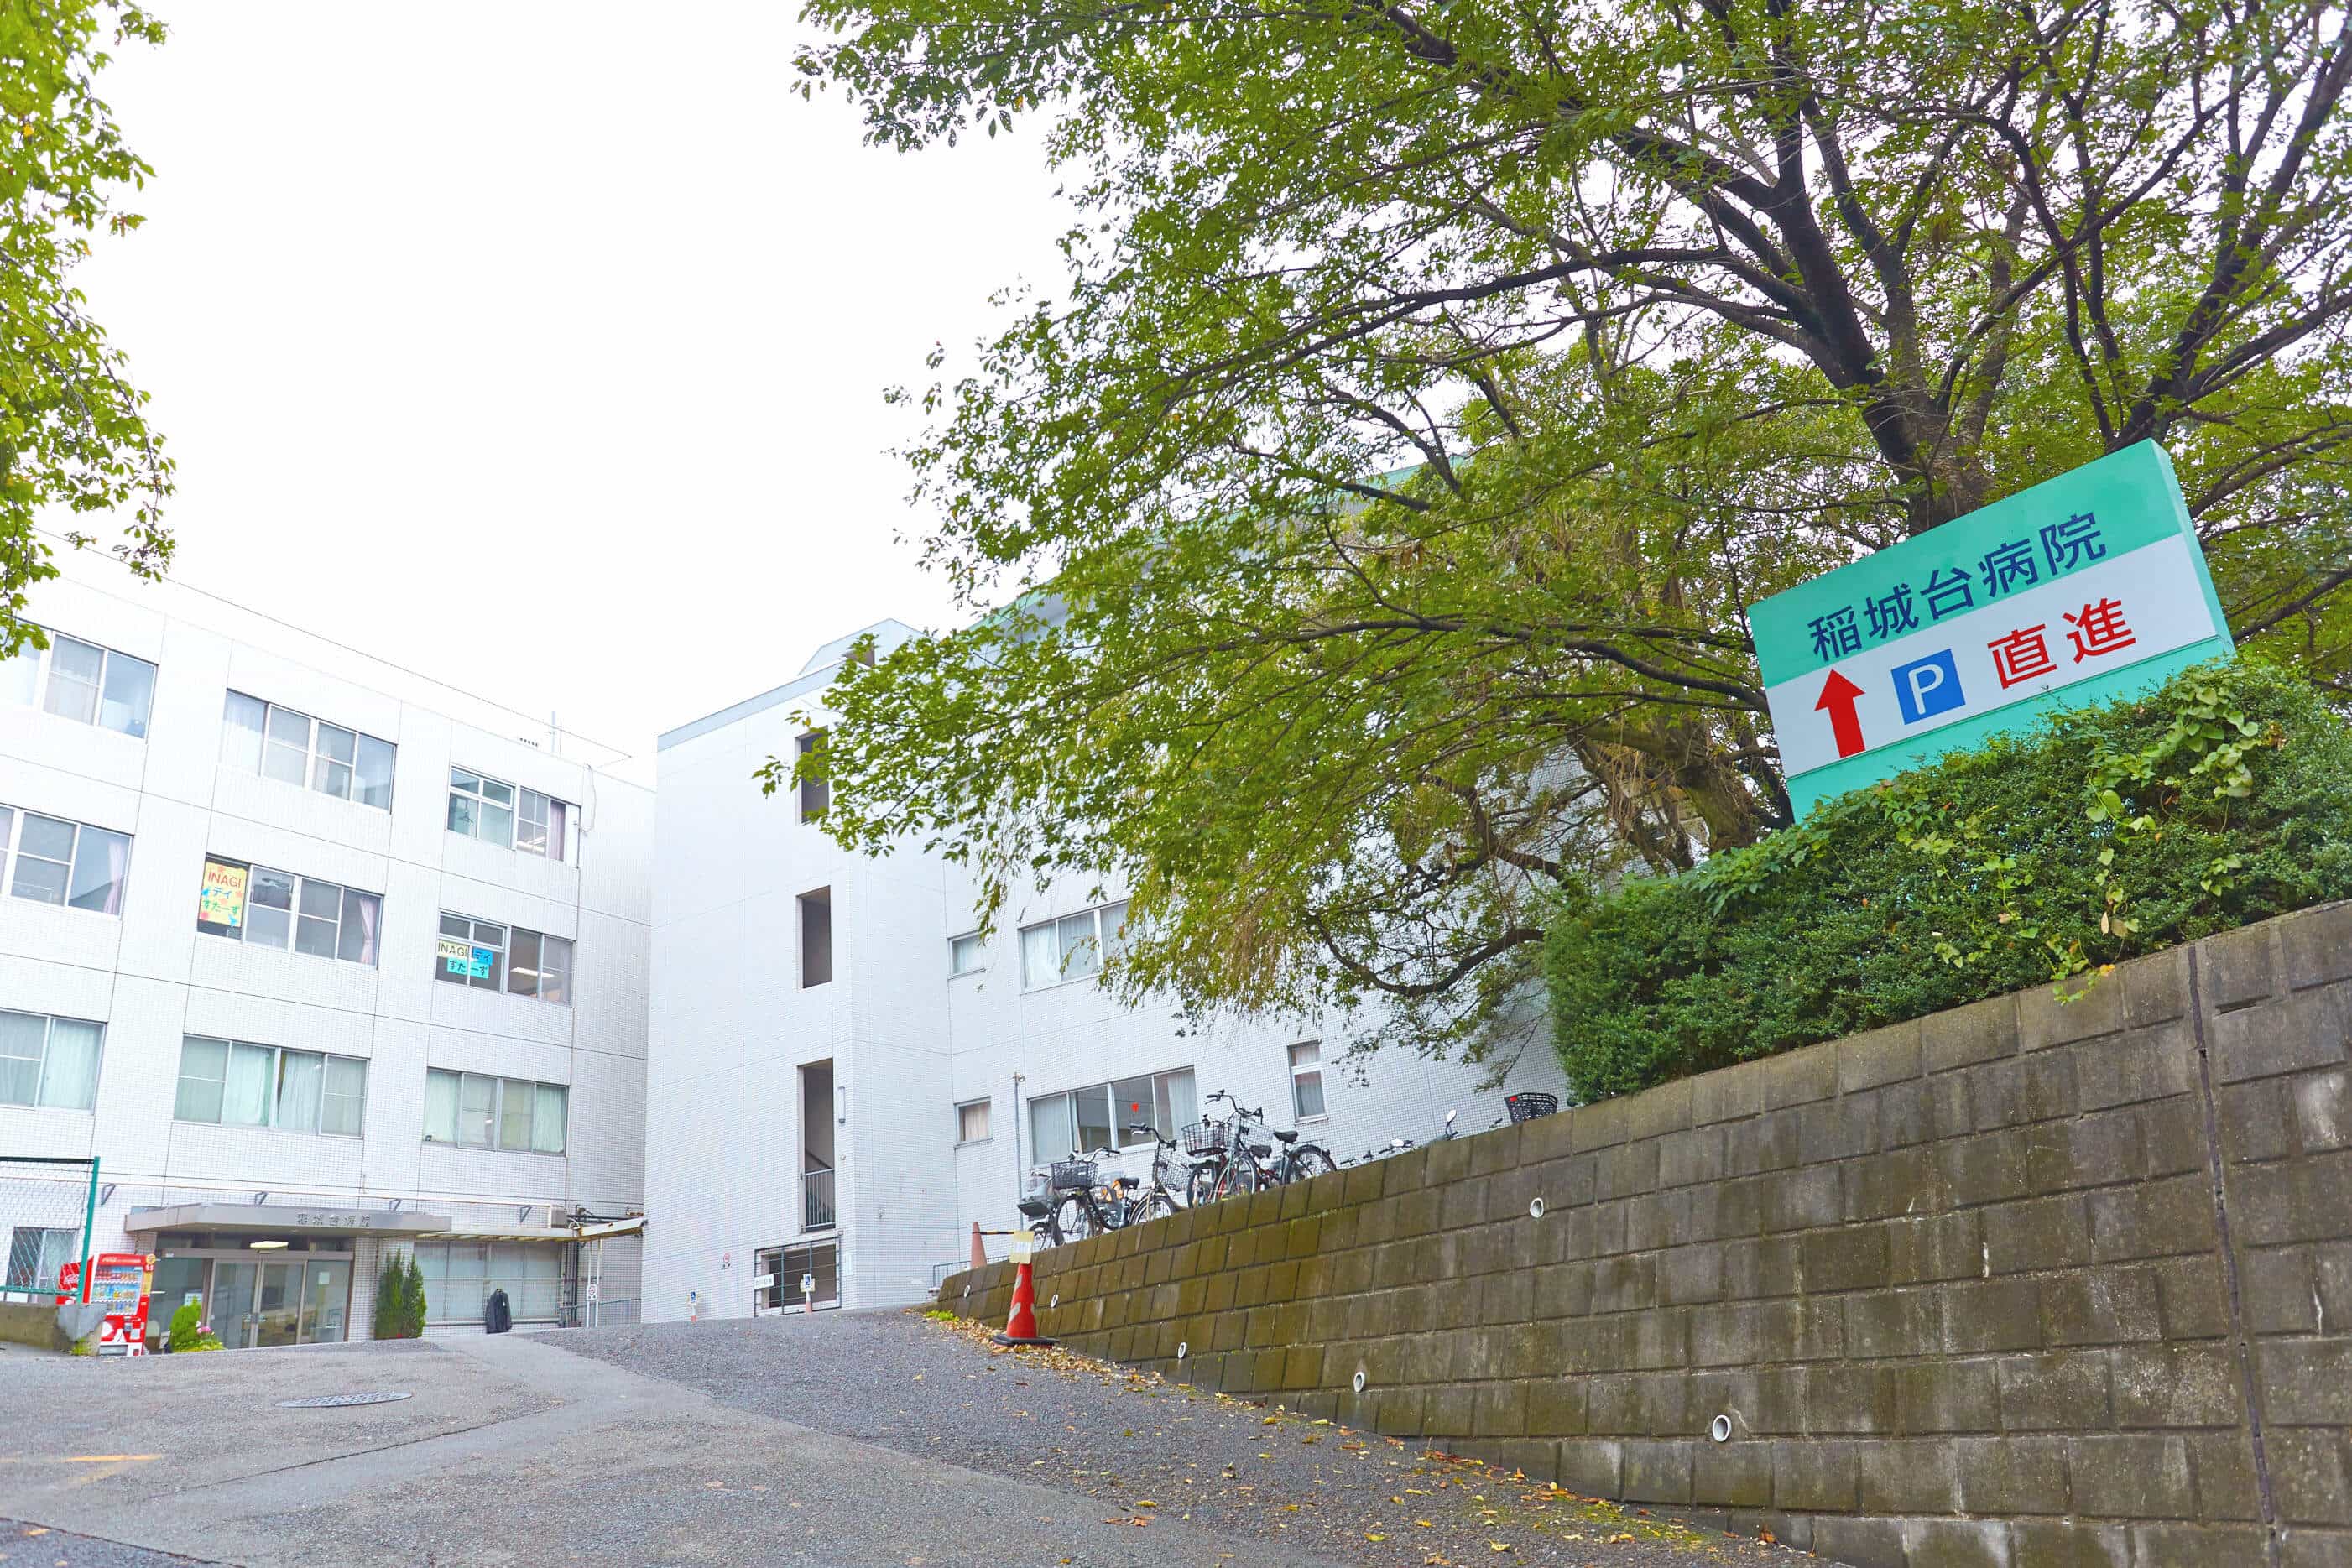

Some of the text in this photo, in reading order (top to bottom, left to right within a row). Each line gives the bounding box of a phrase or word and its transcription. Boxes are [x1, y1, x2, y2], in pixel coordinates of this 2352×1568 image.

[1807, 511, 2108, 663] 稲城台病院
[1907, 597, 2137, 715] P 直進
[208, 871, 242, 888] INAGI
[437, 941, 467, 958] INAGI
[449, 960, 488, 977] すたーず
